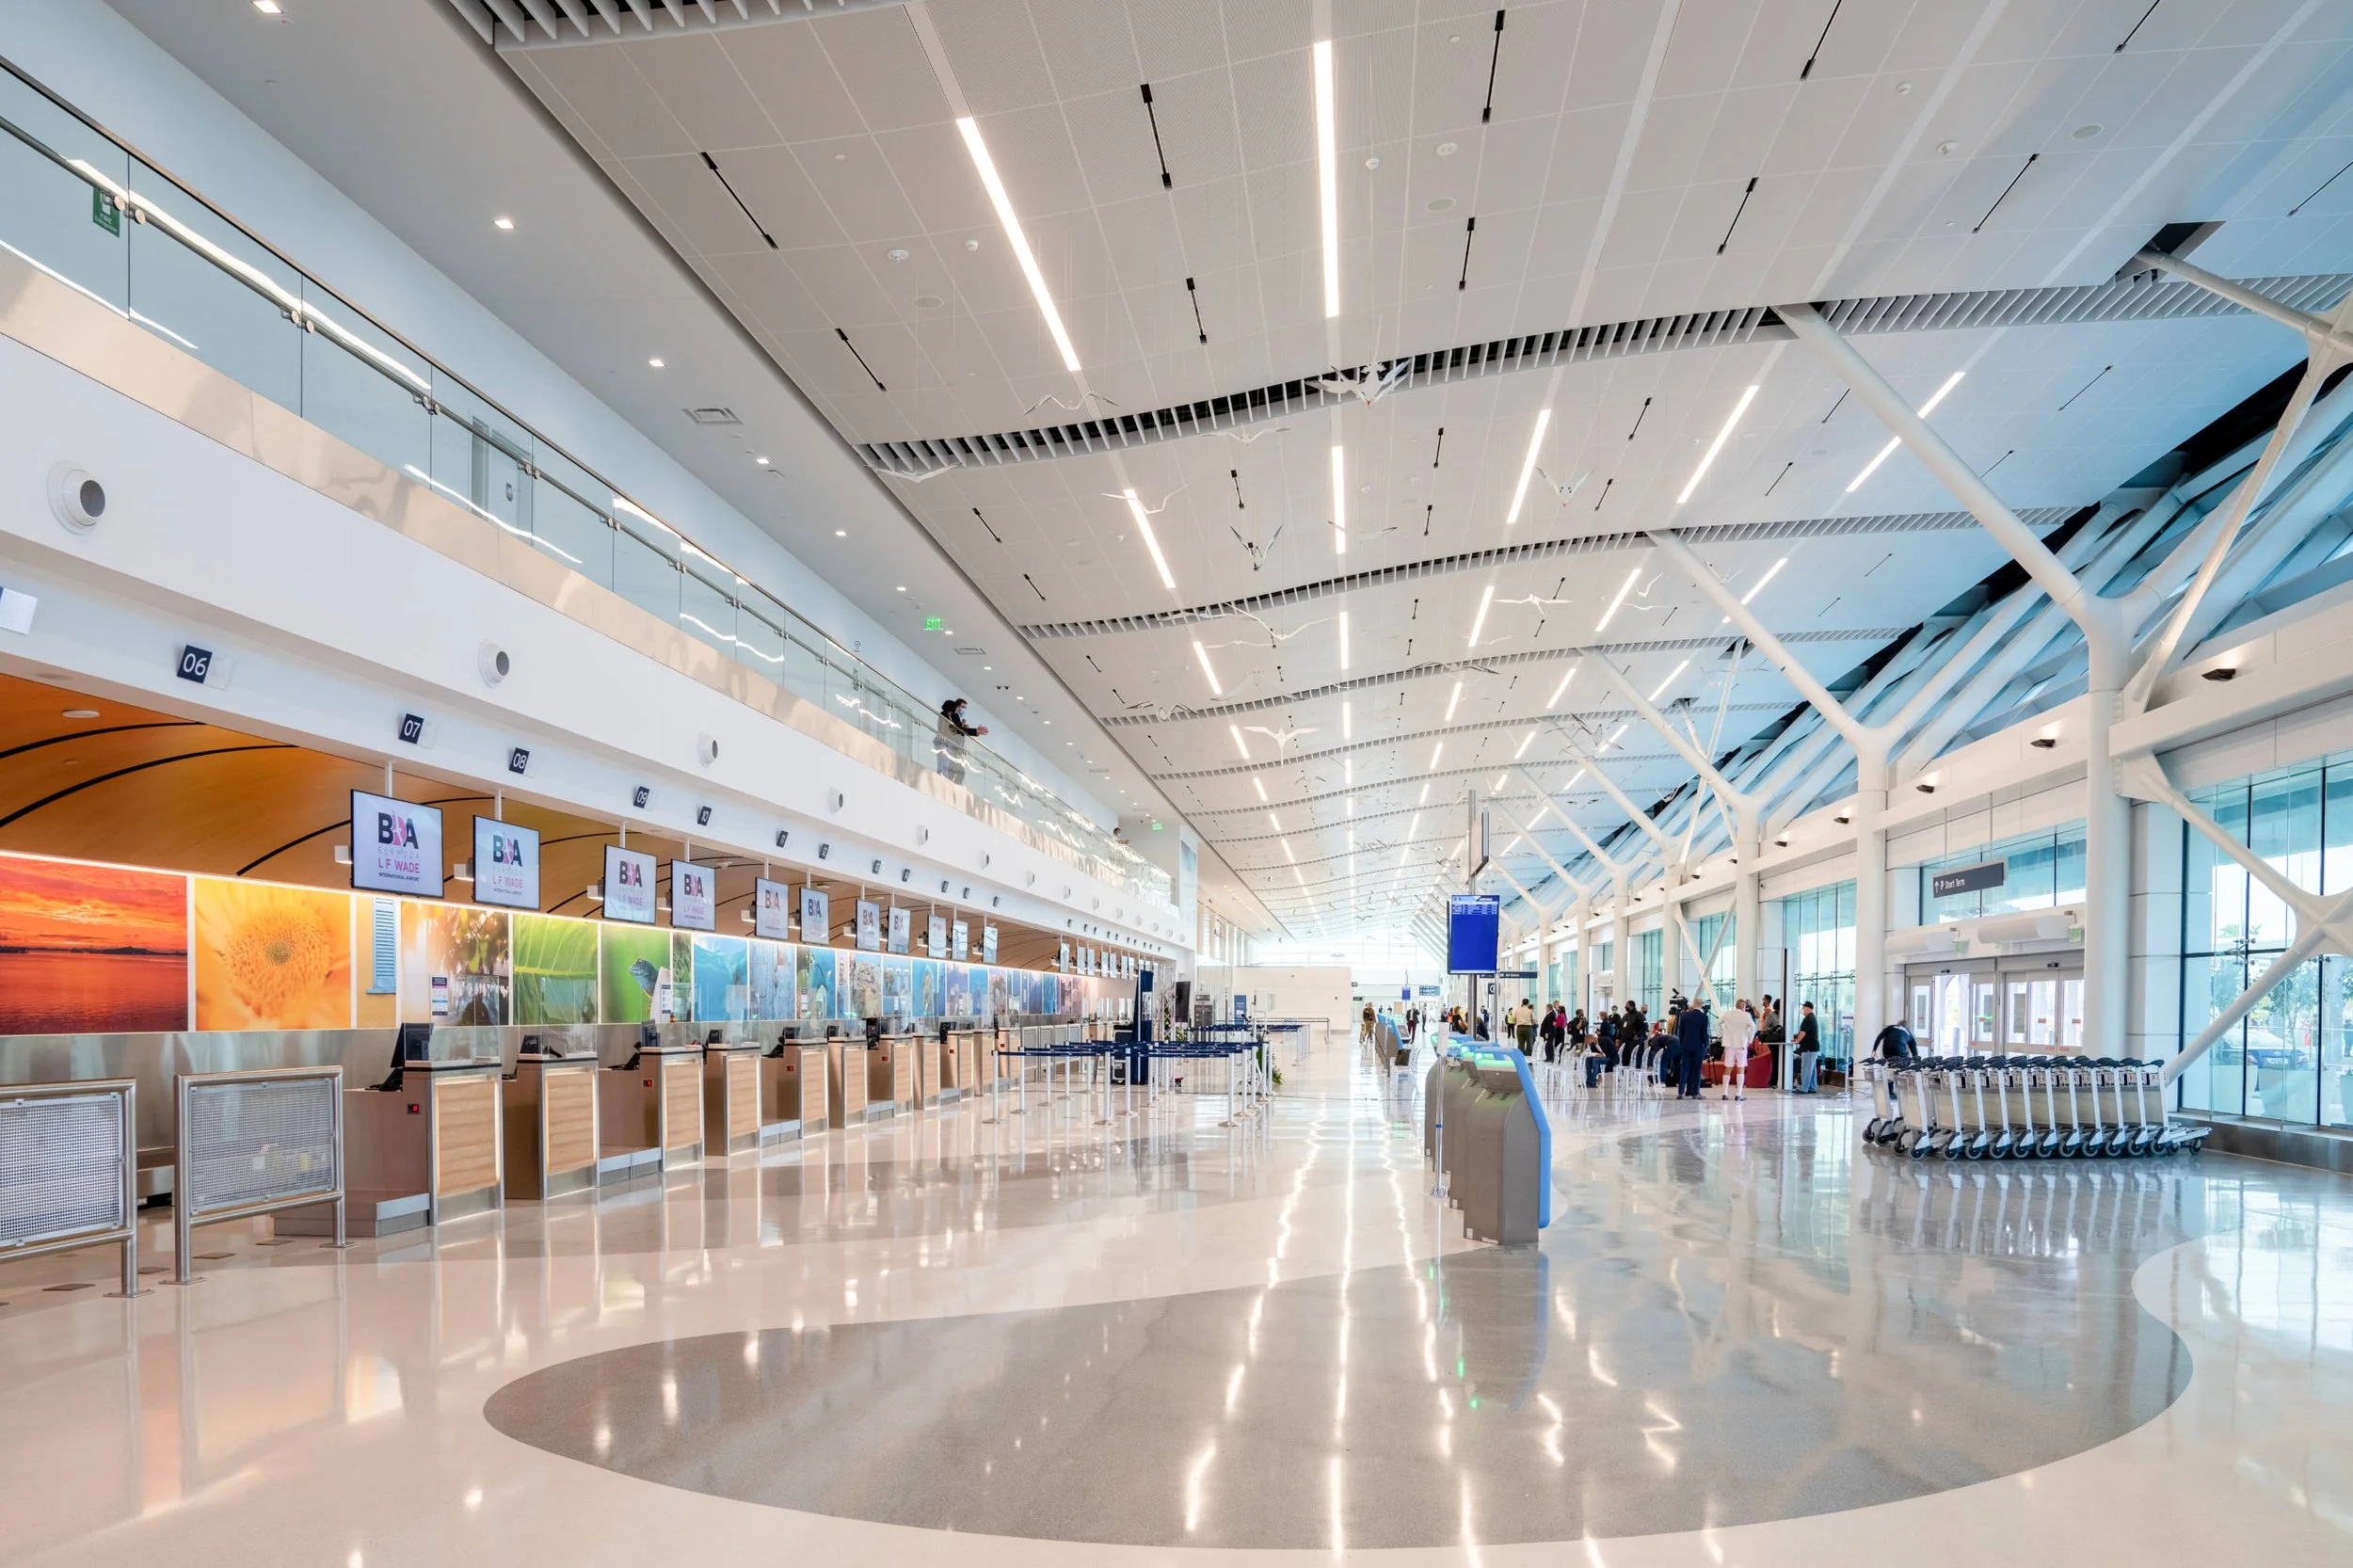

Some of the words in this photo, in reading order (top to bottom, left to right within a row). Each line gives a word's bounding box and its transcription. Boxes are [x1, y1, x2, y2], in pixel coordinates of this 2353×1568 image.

[926, 616, 941, 630] EXIT
[184, 652, 208, 677] 06
[404, 719, 421, 739] 07
[513, 753, 527, 770] 08
[636, 790, 648, 805] 09
[701, 810, 710, 823] 10
[378, 857, 383, 869] L
[386, 858, 392, 869] F
[394, 859, 420, 873] WADE
[1945, 880, 1955, 889] Short
